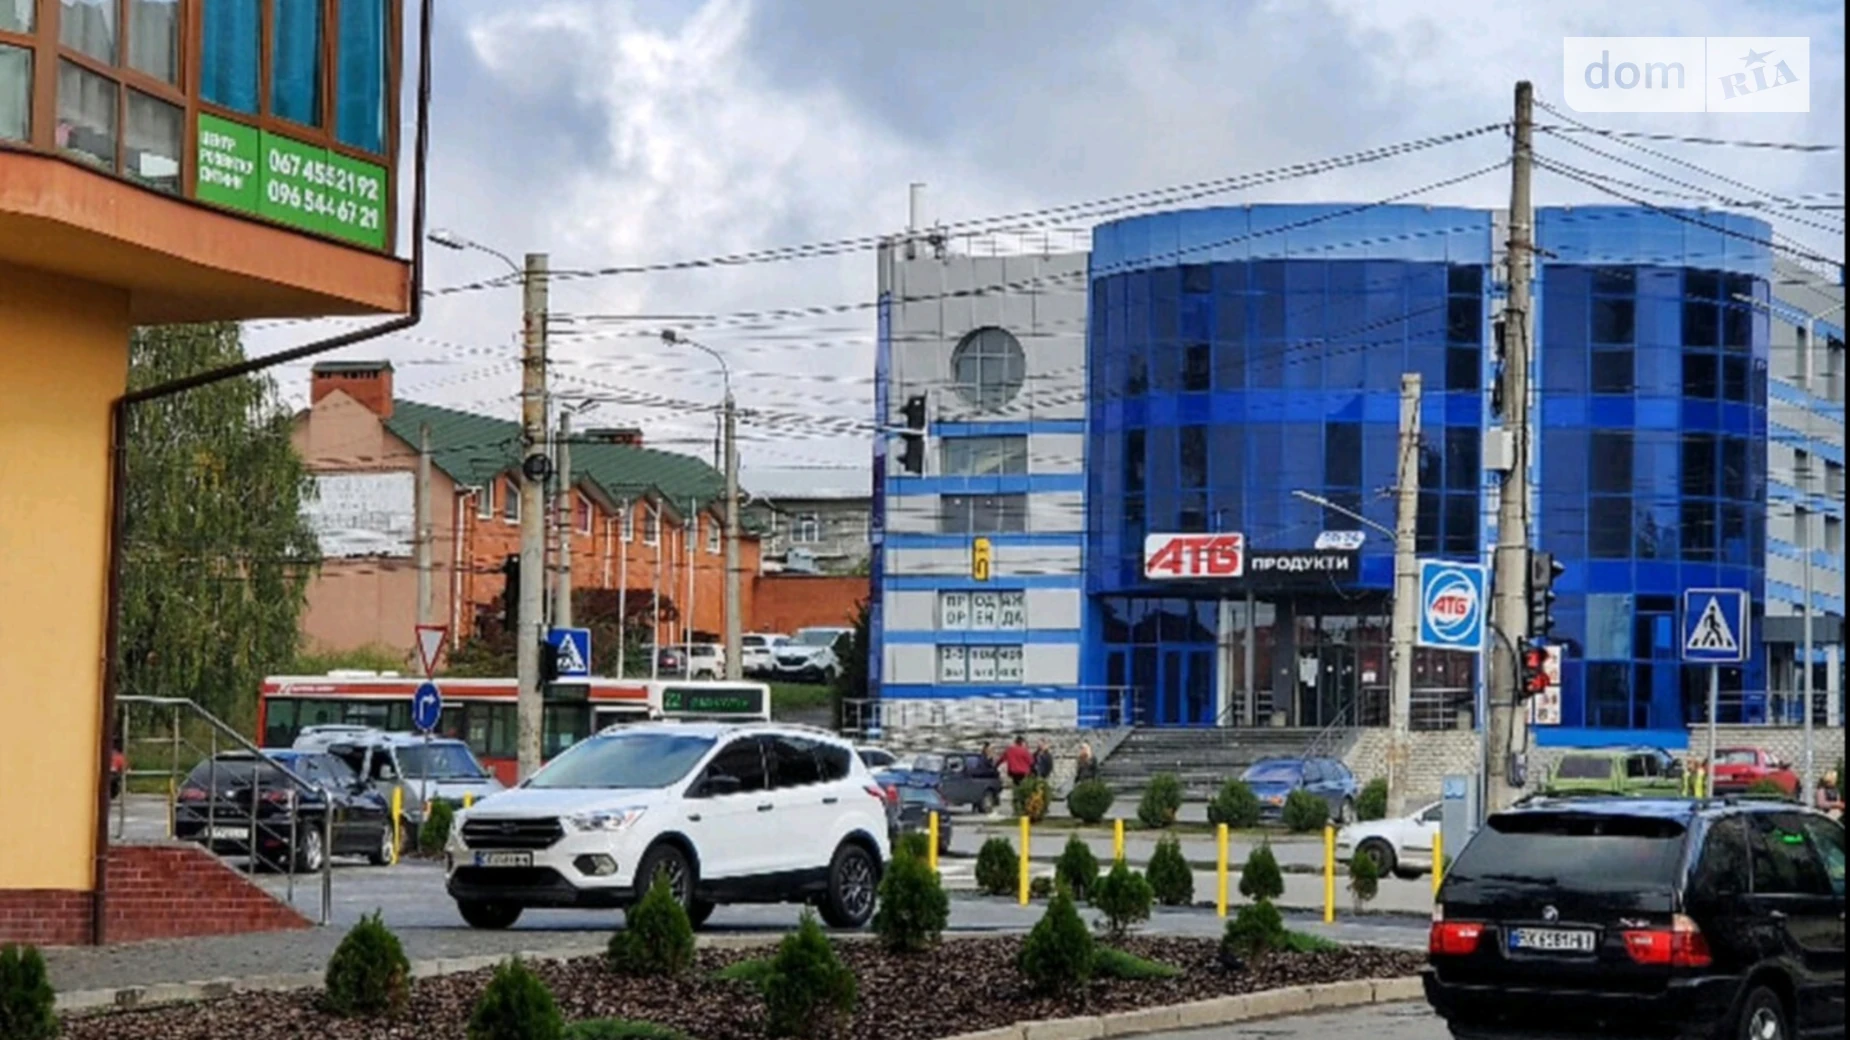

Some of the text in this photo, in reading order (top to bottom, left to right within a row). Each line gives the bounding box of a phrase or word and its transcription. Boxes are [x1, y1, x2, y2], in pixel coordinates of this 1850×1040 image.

[268, 148, 301, 177] 067
[267, 179, 301, 208] 096
[1147, 536, 1349, 576] АТБ ПРОДУКТИ
[1432, 595, 1470, 614] АТБ
